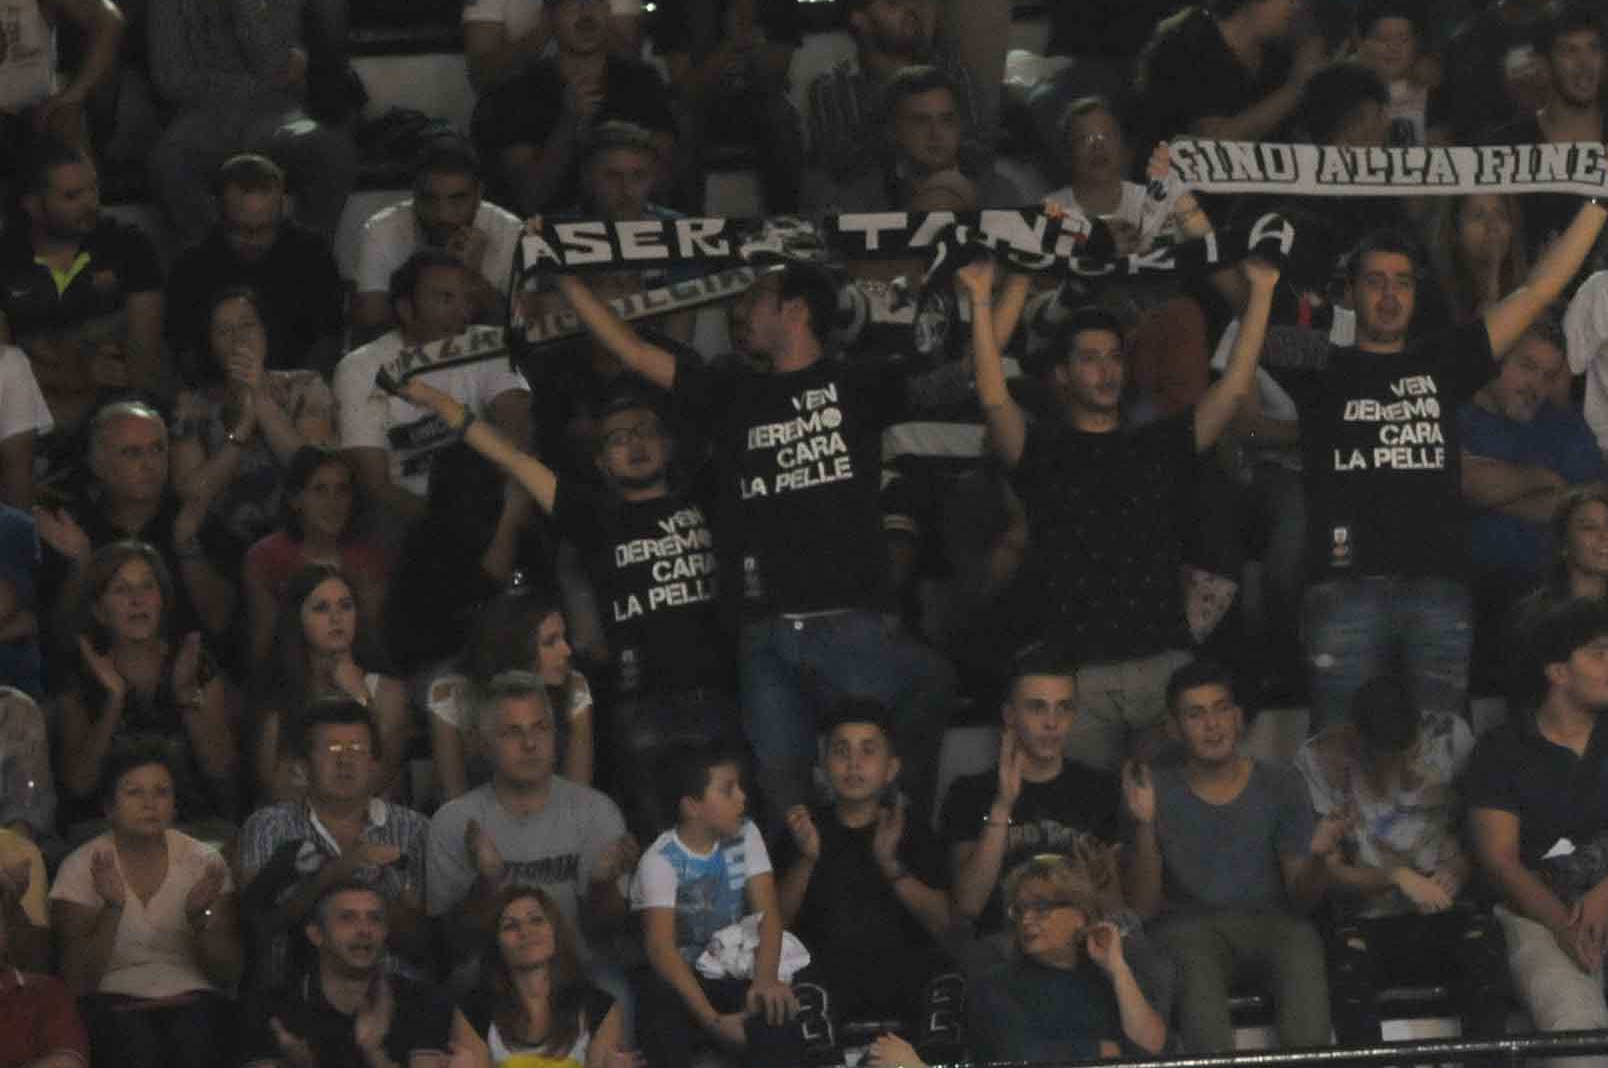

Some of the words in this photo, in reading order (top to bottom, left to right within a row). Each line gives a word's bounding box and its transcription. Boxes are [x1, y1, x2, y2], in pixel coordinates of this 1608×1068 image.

[1173, 141, 1299, 183] FINO
[1316, 144, 1459, 186] ALLA
[1474, 141, 1608, 187] FINE
[1390, 375, 1438, 397] VEN
[1378, 421, 1446, 445] CARA
[776, 432, 847, 469] CARA
[1333, 448, 1368, 471] LA
[1372, 446, 1446, 470] PELLE
[740, 476, 768, 500] LA
[774, 456, 854, 493] PELLE
[612, 593, 644, 623] LA
